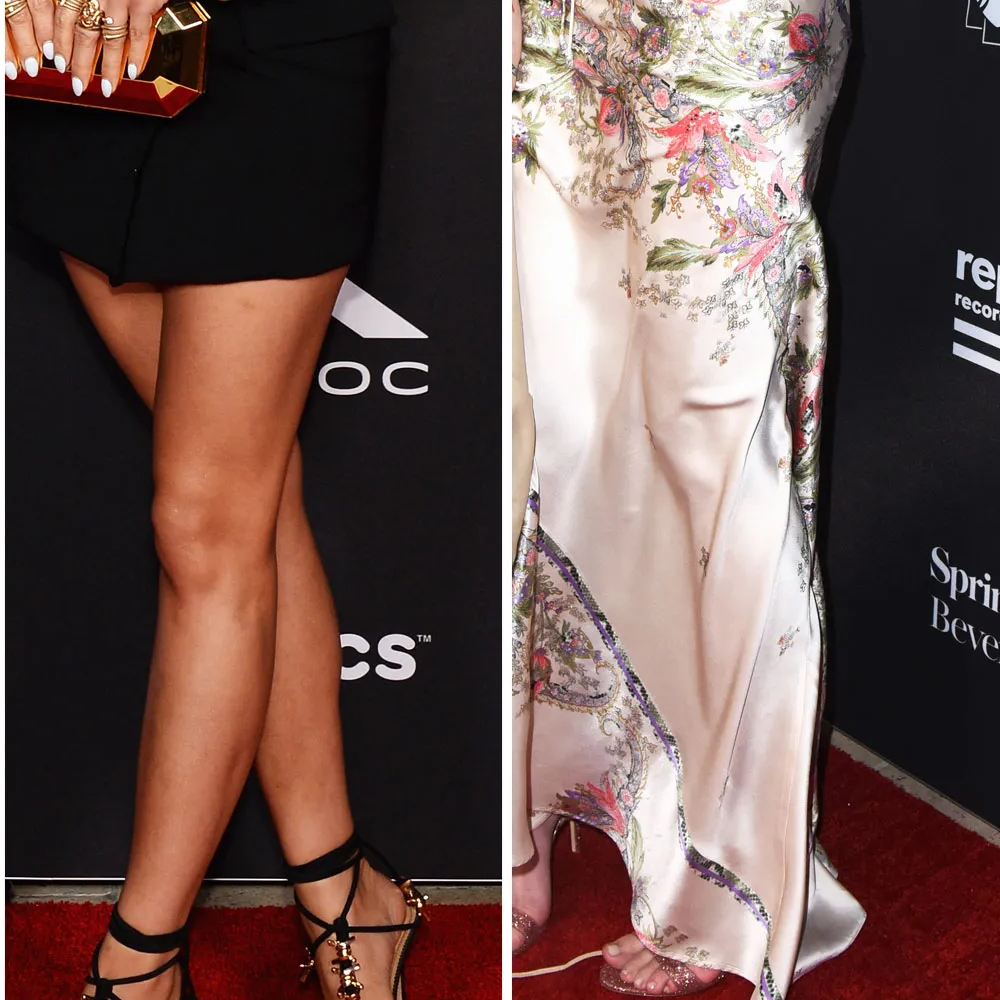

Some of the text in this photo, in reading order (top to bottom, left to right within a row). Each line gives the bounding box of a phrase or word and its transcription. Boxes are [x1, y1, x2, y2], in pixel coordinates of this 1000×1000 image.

[956, 249, 1000, 305] re
[955, 292, 1000, 322] recor
[318, 361, 429, 396] OC
[931, 594, 1000, 665] Beve
